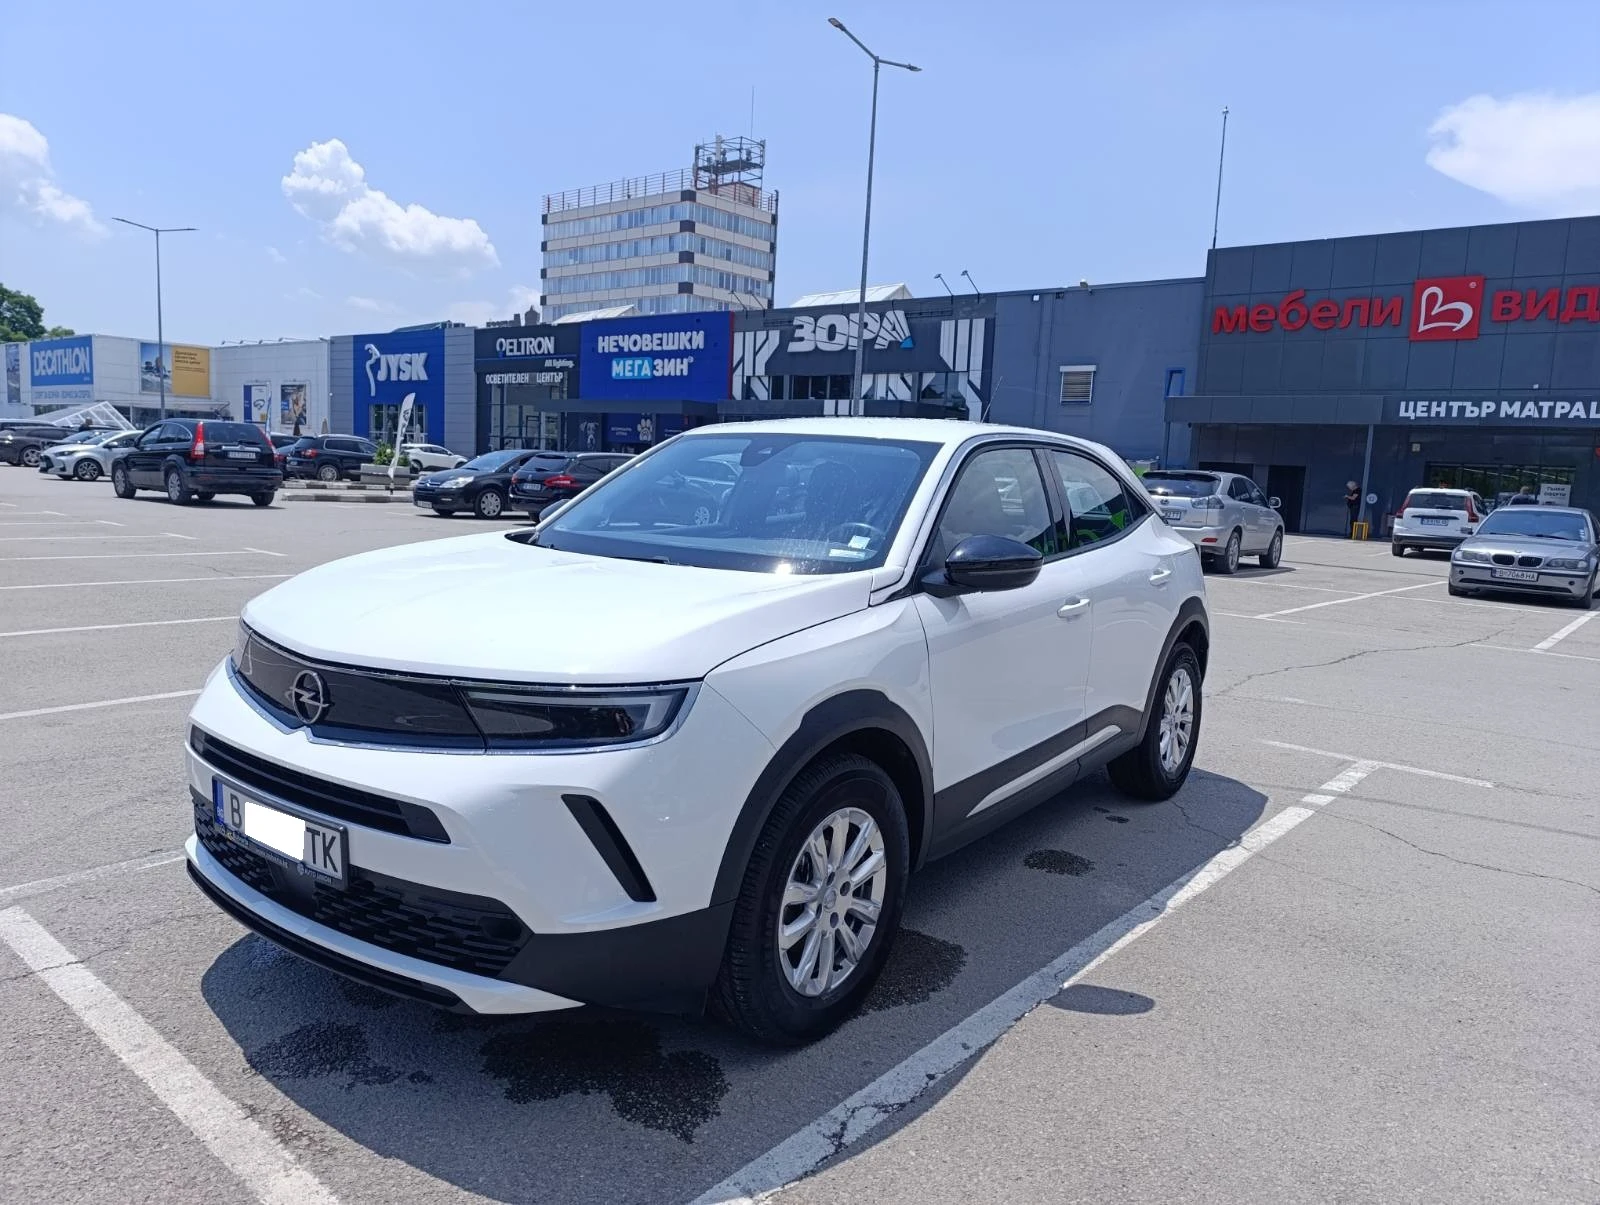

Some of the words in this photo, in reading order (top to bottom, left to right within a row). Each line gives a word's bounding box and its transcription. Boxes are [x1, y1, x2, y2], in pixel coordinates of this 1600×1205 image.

[1212, 289, 1404, 335] мебели
[597, 330, 705, 353] НЕЧОВЕШКИ
[787, 309, 914, 353] ЗОРА
[33, 346, 90, 377] DECATHLON
[376, 352, 428, 382] JYSK
[485, 372, 529, 385] ОСВЕТИТЕЛЕН
[536, 371, 564, 384] ЦЕНТЪР
[1398, 401, 1496, 420] ЦЕНТЪР
[230, 793, 242, 829] B
[305, 826, 338, 873] TK
